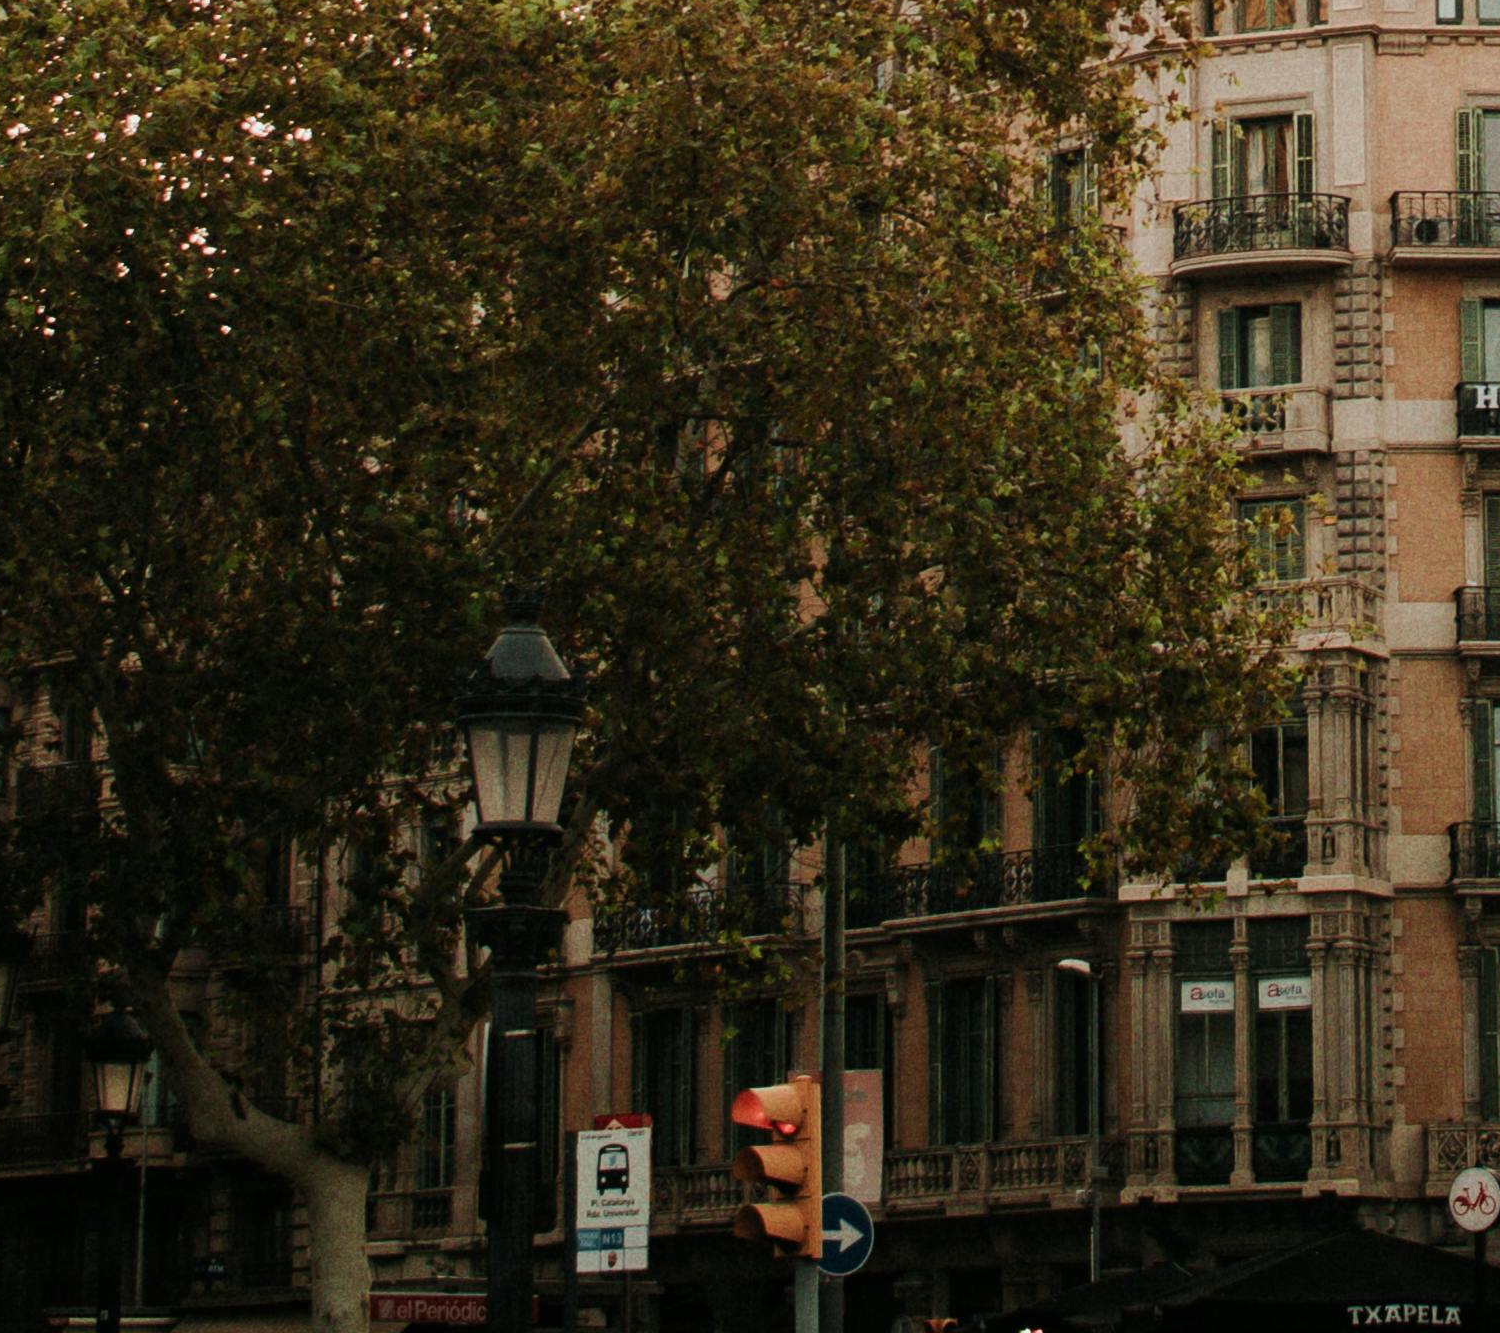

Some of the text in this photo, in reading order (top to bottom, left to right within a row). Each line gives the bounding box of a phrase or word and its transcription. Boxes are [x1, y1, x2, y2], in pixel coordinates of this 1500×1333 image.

[602, 1232, 622, 1245] N13
[396, 1299, 487, 1322] el Periódic
[1346, 1303, 1461, 1325] TXAPELA
